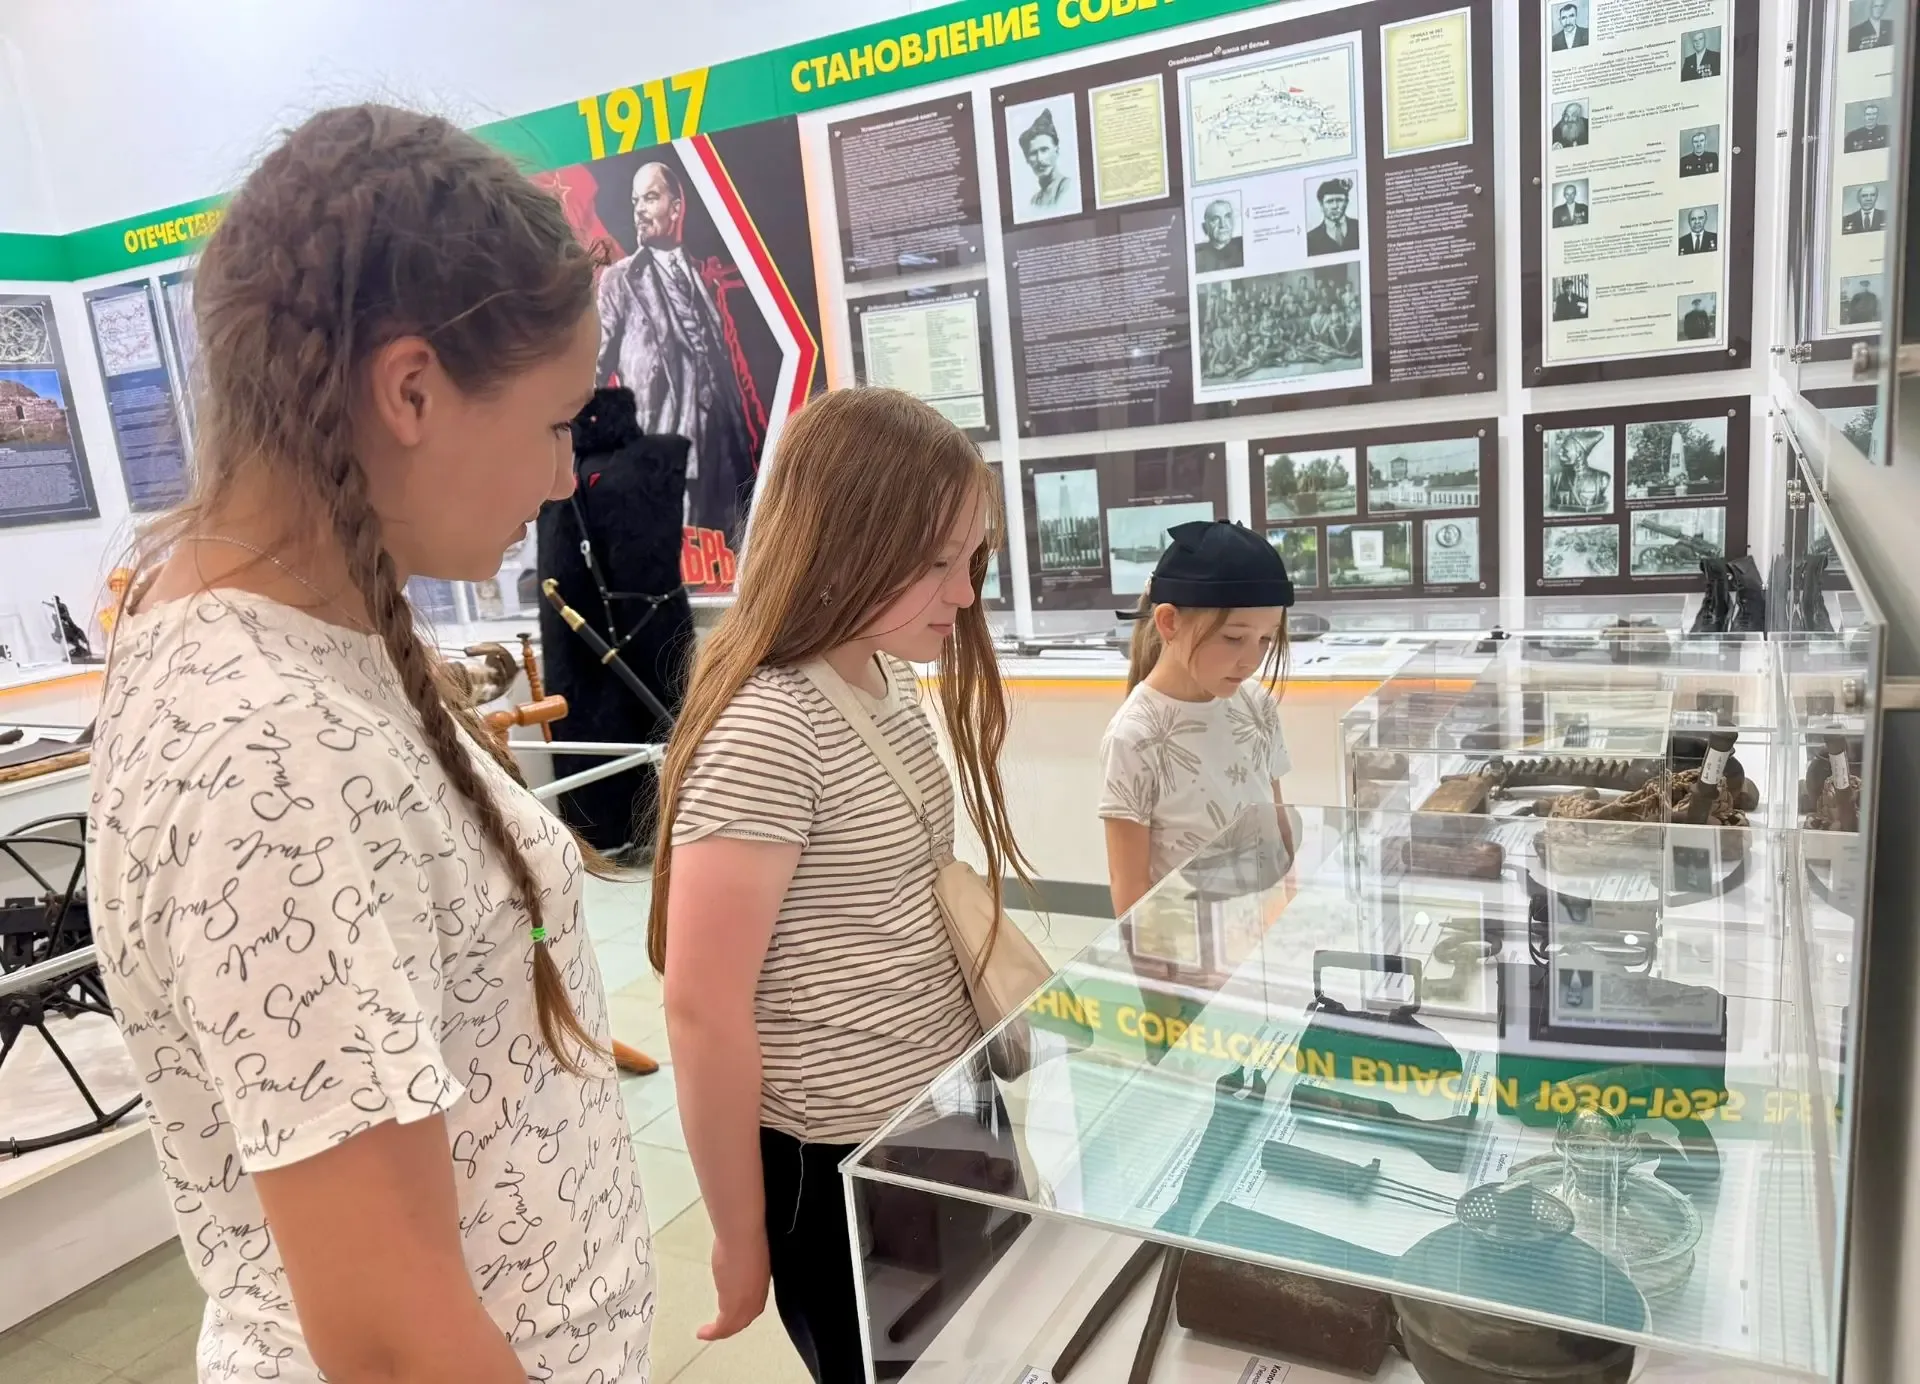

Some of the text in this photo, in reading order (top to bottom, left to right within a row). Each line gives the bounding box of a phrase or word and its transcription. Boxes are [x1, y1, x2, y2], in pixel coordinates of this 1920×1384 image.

[791, 2, 1040, 93] СТАНОВЛЕНИЕ
[577, 67, 709, 161] 1917
[153, 641, 247, 690] Smile
[246, 720, 314, 821] Smile
[225, 830, 334, 887] Smile
[217, 897, 315, 982] Smile
[264, 949, 354, 1038] Smile
[235, 1052, 343, 1101] Smile
[452, 1096, 526, 1179] Smile
[475, 1240, 557, 1293] Smile
[547, 1238, 602, 1322] Smile
